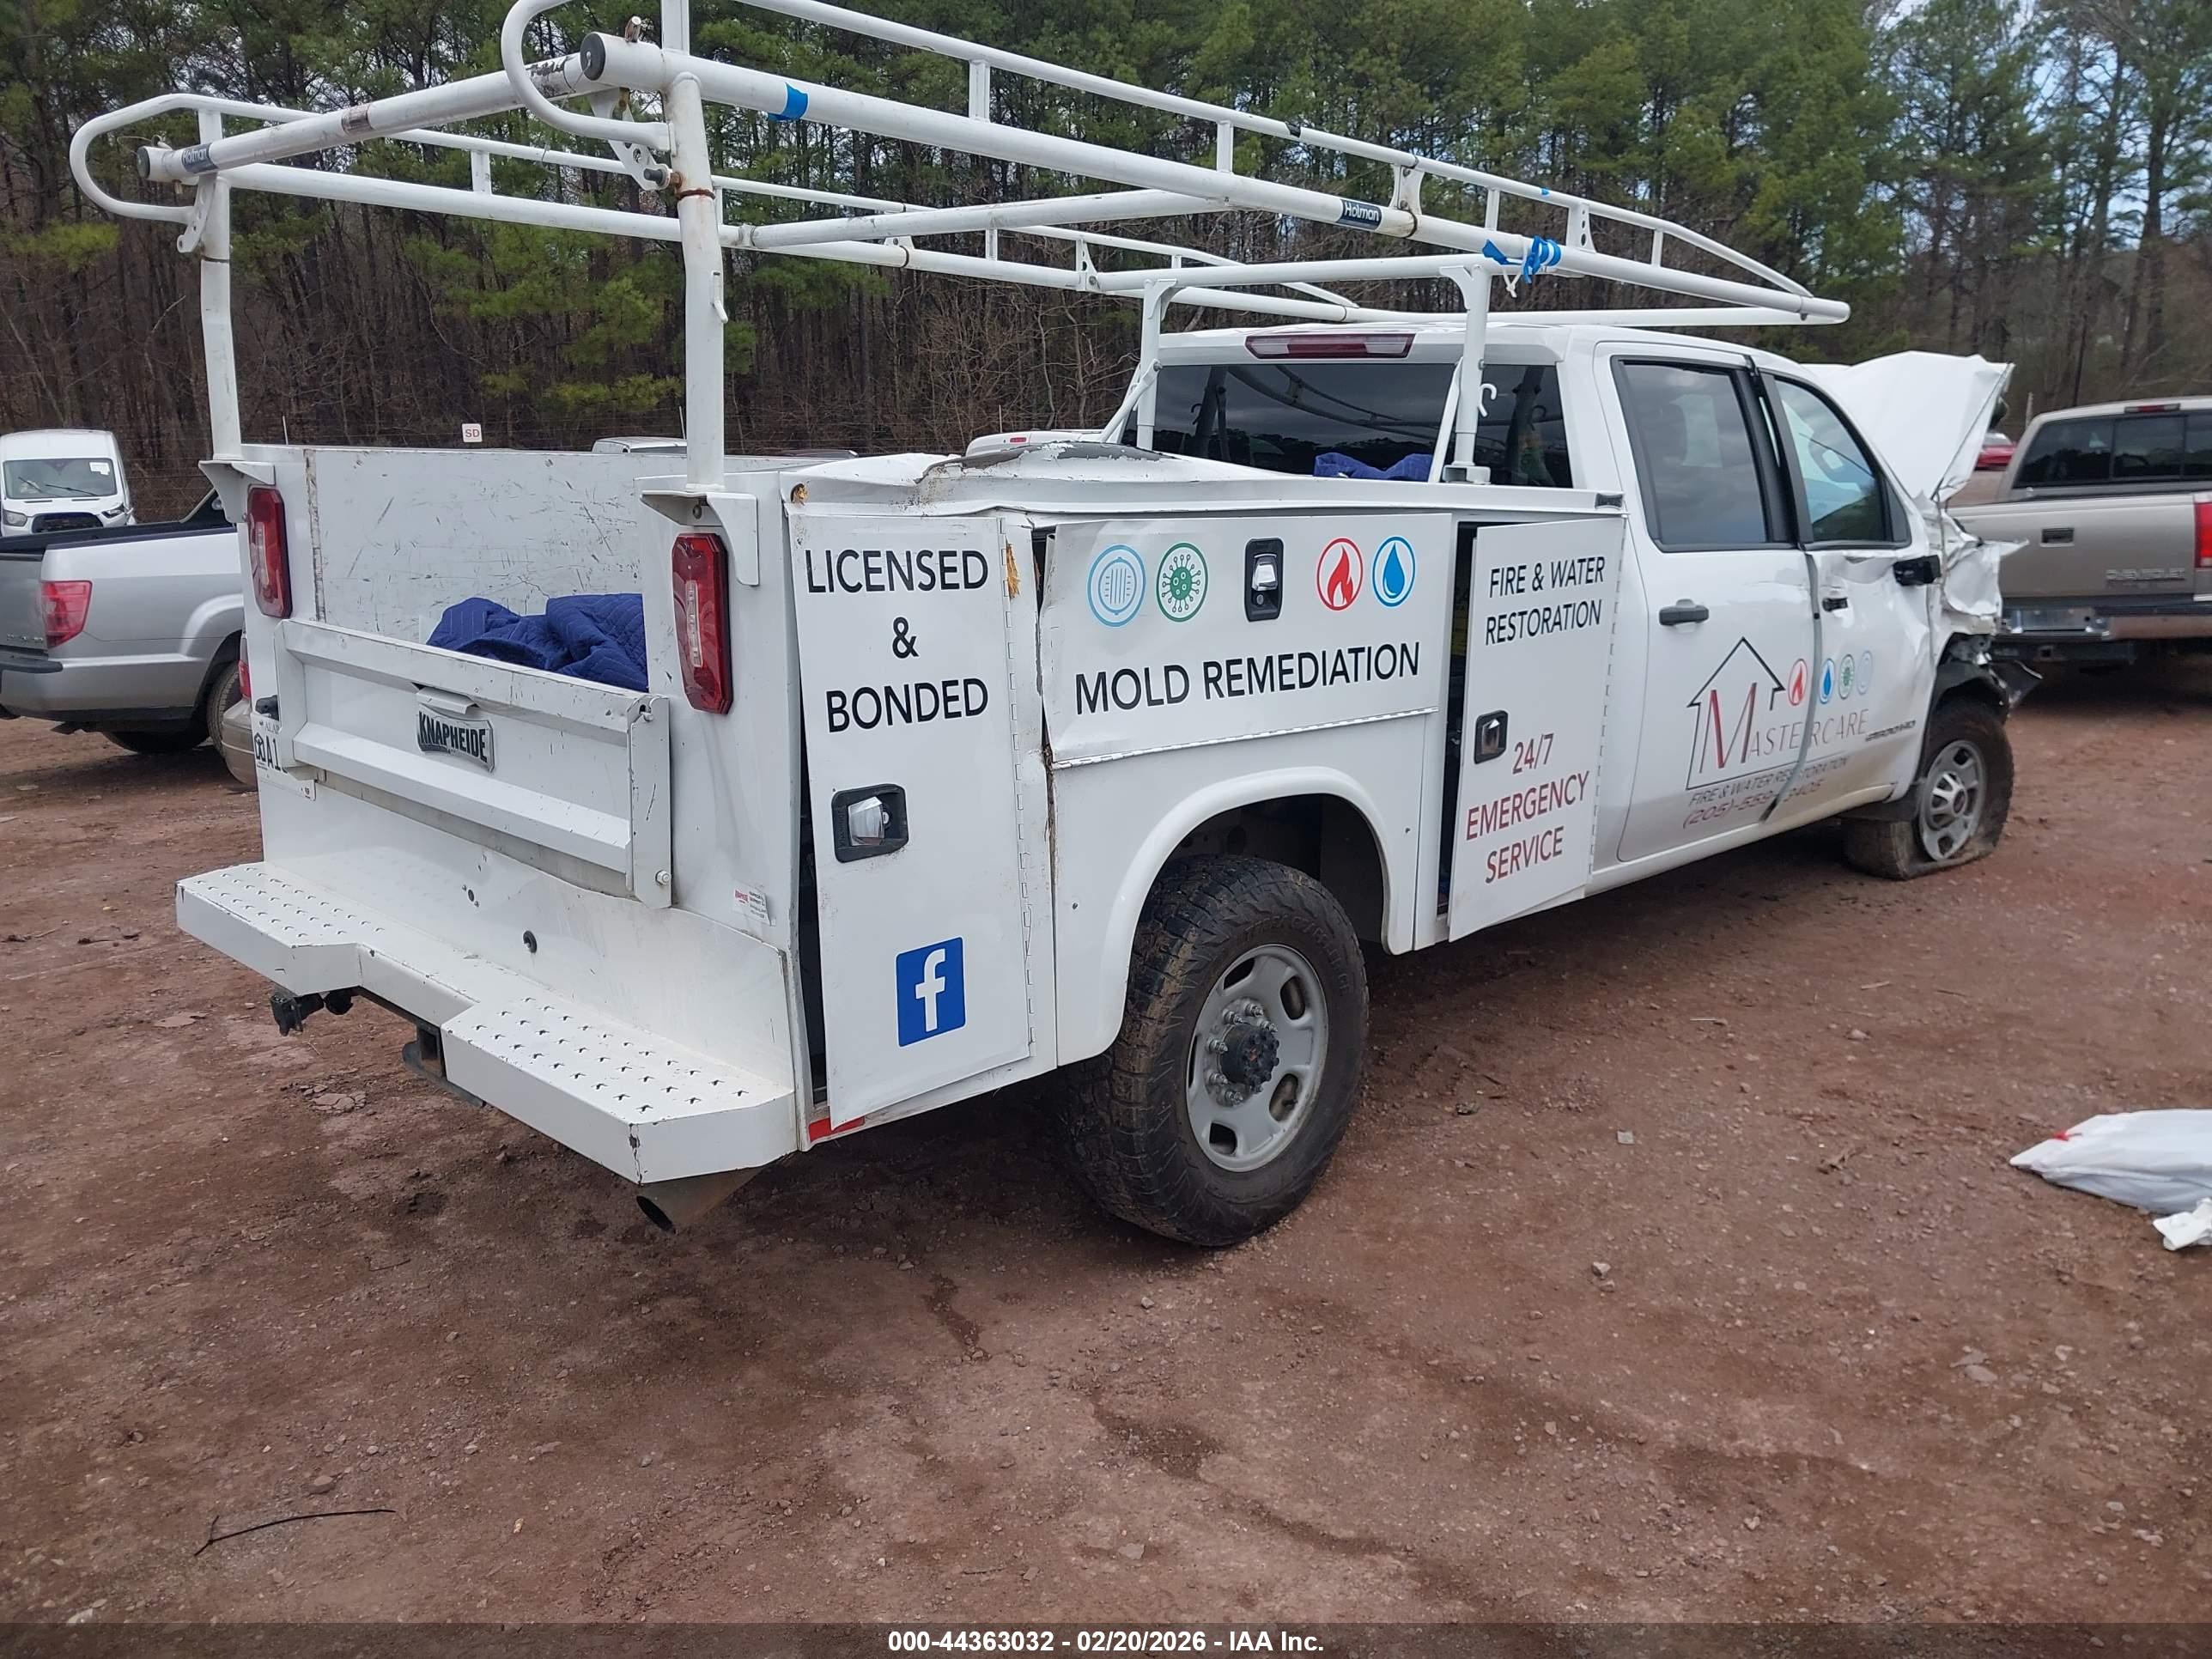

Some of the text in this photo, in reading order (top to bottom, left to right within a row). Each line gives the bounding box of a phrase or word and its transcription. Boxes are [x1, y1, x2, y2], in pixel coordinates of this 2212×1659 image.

[1345, 202, 1379, 222] Holman
[465, 428, 480, 438] SD
[805, 549, 988, 593] LICENSED
[1489, 556, 1606, 598] FIRE & WATER
[891, 616, 920, 659] &
[1485, 599, 1602, 646] RESTORATION
[1076, 641, 1420, 715] MOLD REMEDIATION
[825, 678, 988, 733] BONDED
[418, 710, 488, 763] KNAPHEIDE
[1512, 732, 1554, 775] 24/7
[1466, 770, 1589, 842] EMERGENCY
[1485, 825, 1565, 884] SERVICE
